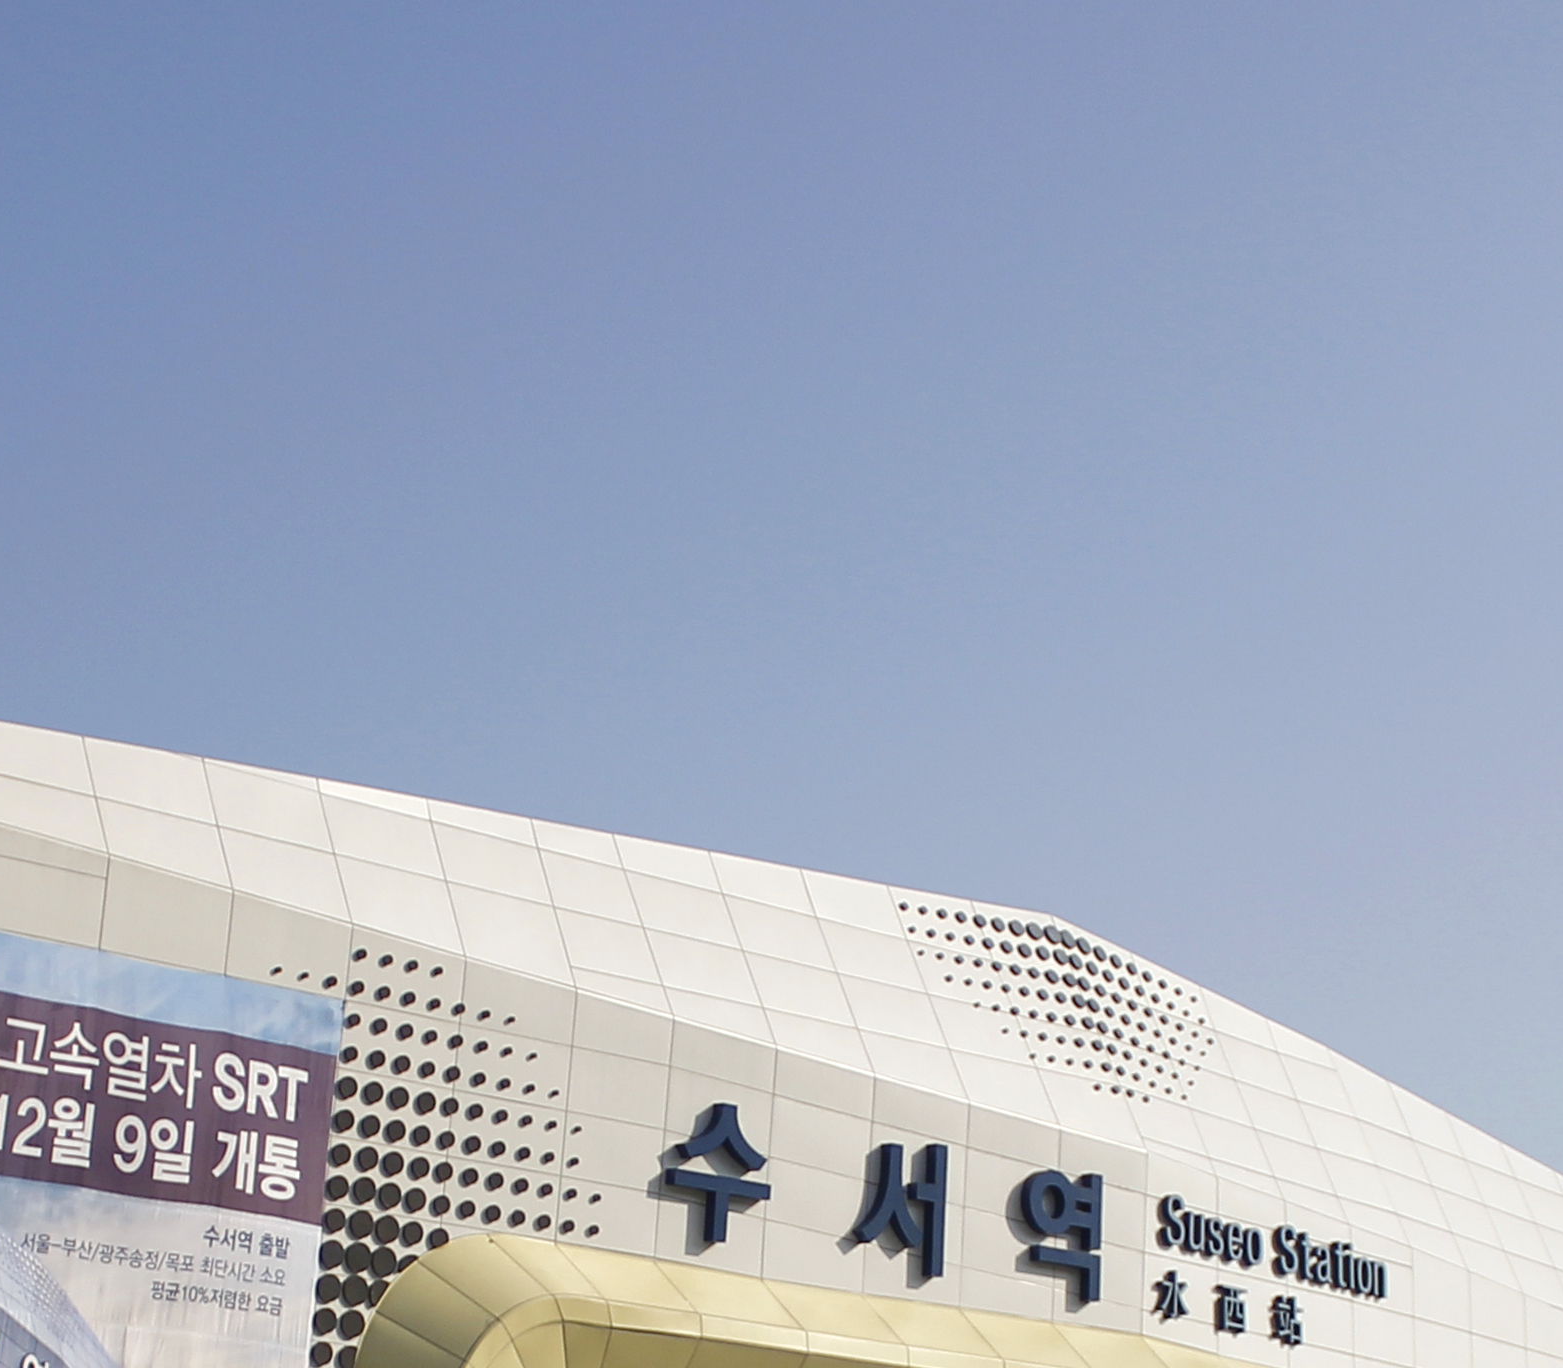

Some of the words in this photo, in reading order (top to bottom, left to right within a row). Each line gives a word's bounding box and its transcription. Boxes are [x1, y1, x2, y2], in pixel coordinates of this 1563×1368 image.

[212, 1051, 310, 1123] SRT
[112, 1113, 196, 1185] 9일
[211, 1129, 302, 1201] 개통
[664, 1102, 1104, 1303] 수서역
[199, 1255, 257, 1285] 최단시간
[259, 1265, 288, 1287] 소요
[202, 1224, 254, 1254] 수서역
[258, 1233, 292, 1260] 출발
[1155, 1193, 1265, 1271] Suseo
[1270, 1224, 1390, 1300] Station
[254, 1293, 284, 1317] 요금
